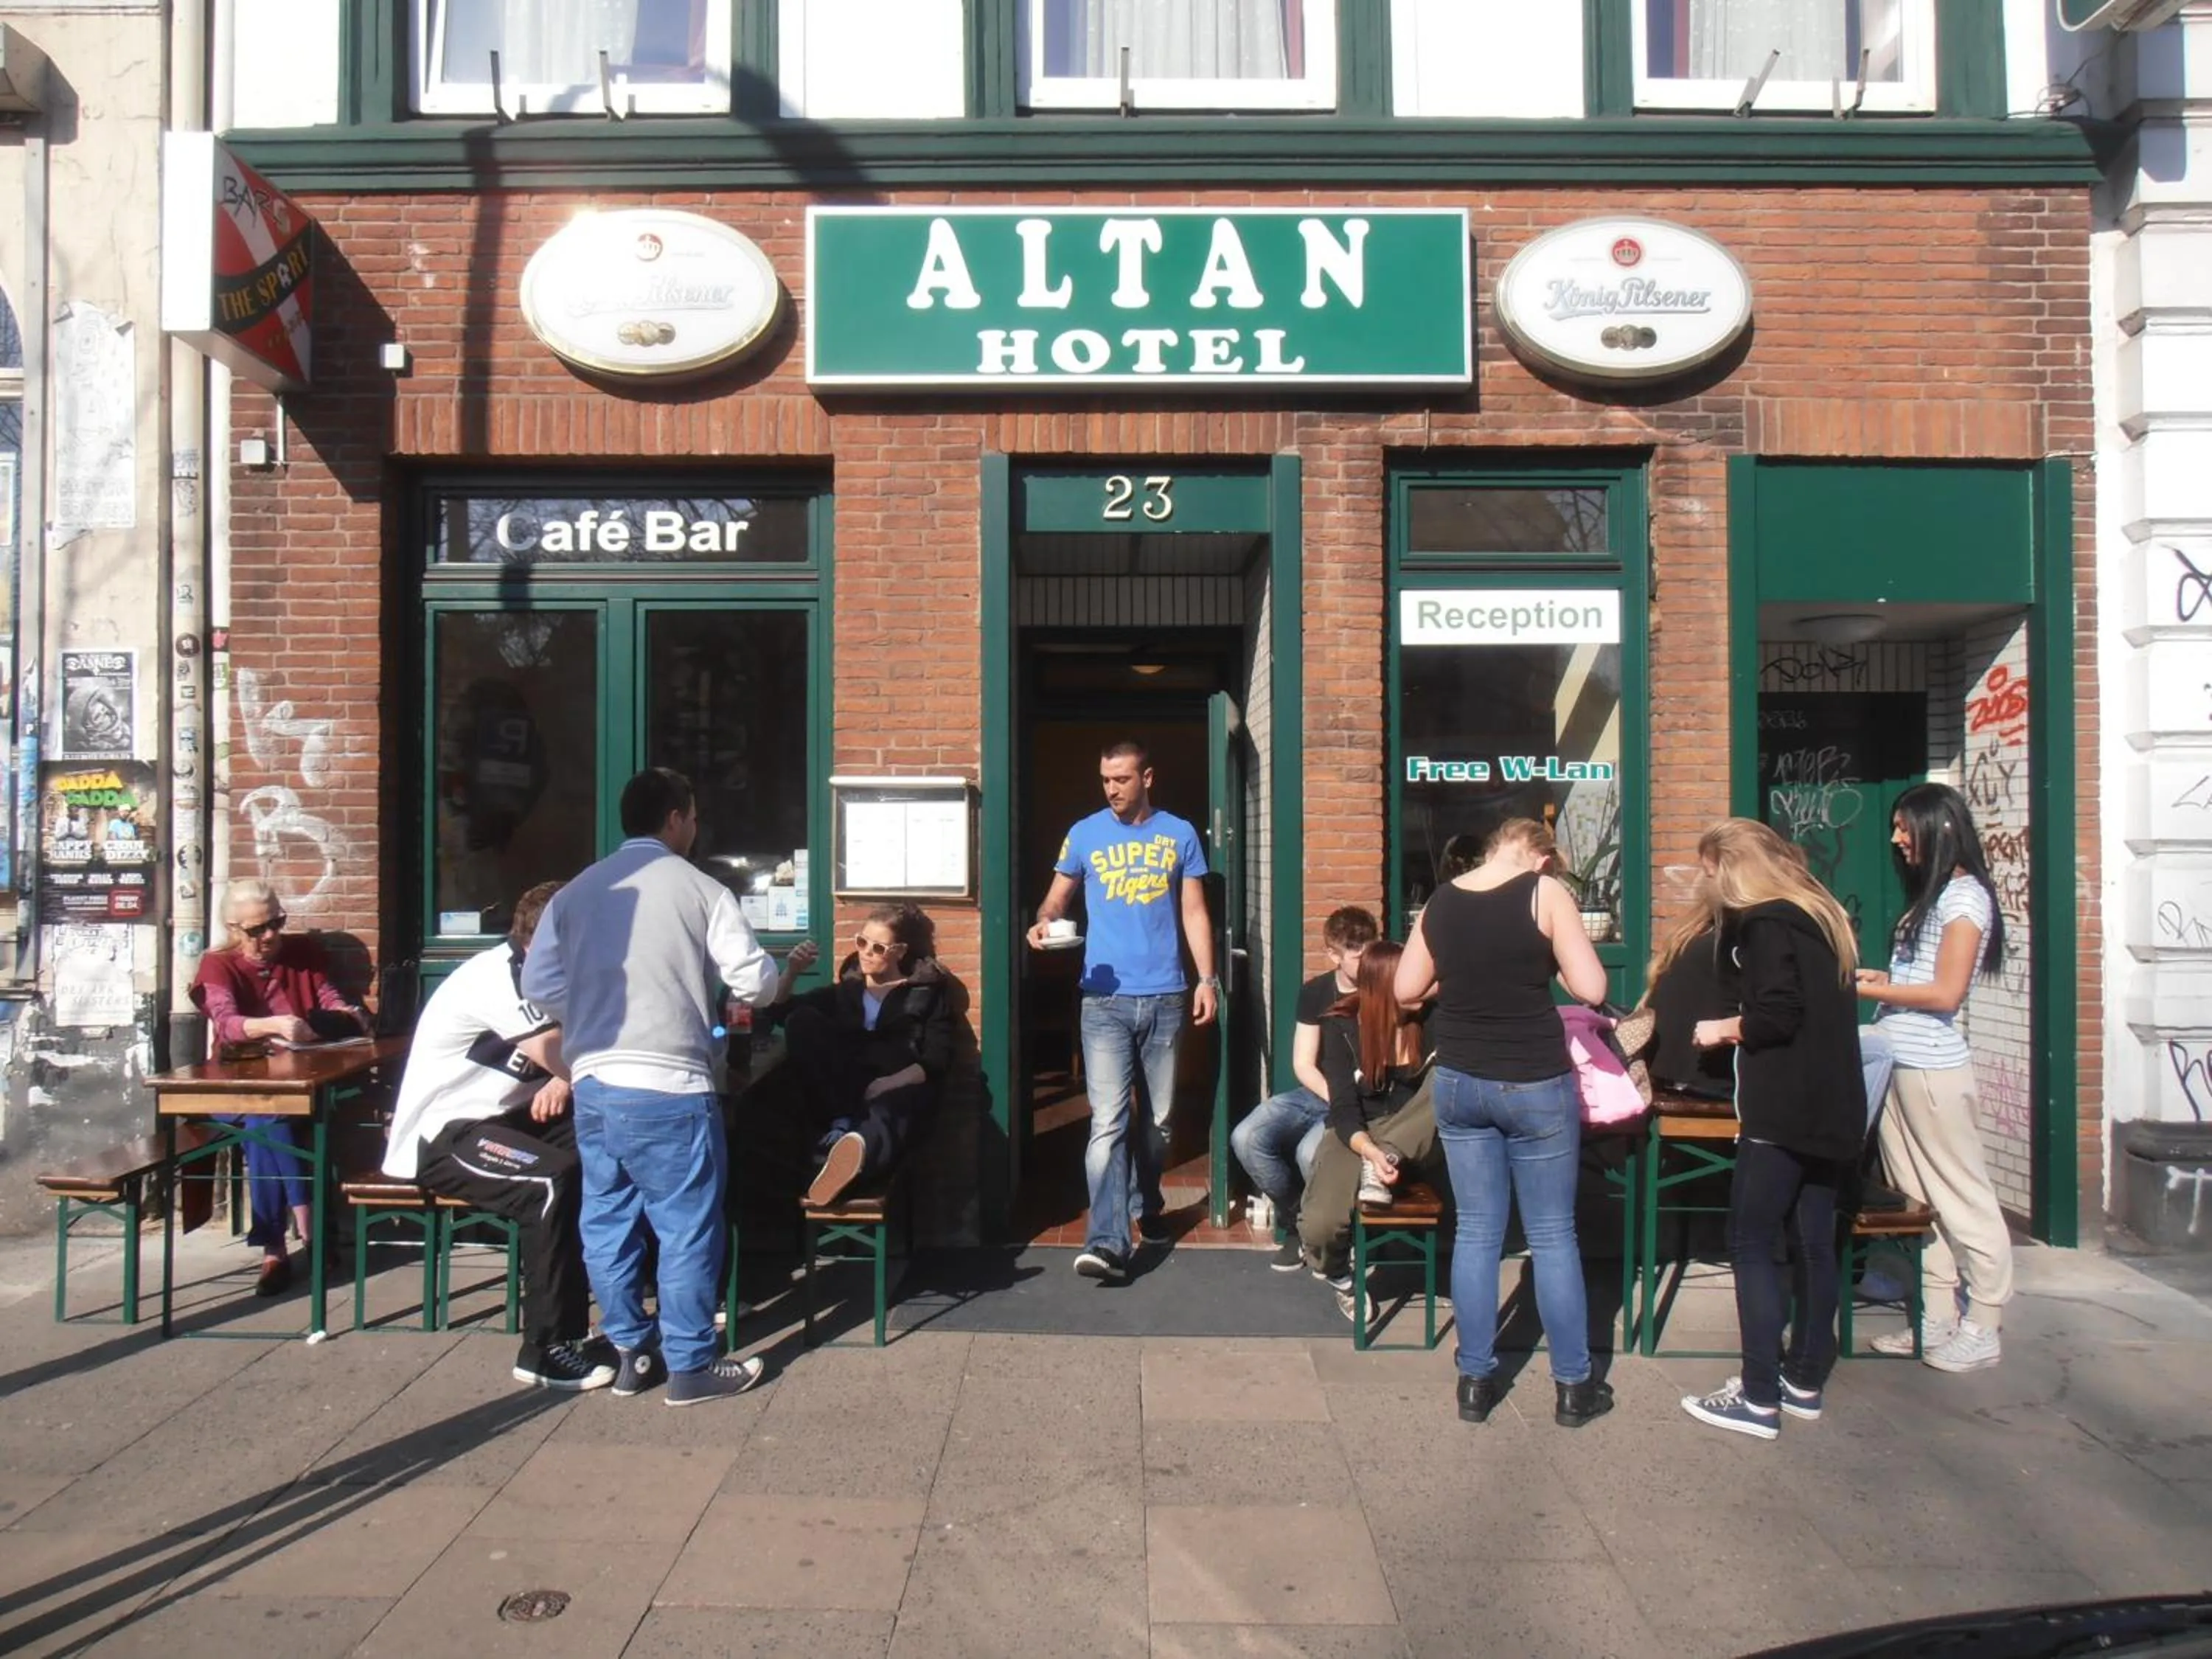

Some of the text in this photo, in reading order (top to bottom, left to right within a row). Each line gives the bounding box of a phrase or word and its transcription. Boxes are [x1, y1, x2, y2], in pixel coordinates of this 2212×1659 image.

[906, 216, 1370, 309] ALTAN
[217, 286, 257, 321] THE
[1618, 277, 1711, 313] Pilsener
[976, 328, 1305, 373] HOTEL
[1103, 475, 1172, 520] 23
[496, 509, 748, 552] Café Bar
[1417, 600, 1603, 636] Reception
[1407, 756, 1613, 782] Free W-Lan
[1091, 842, 1177, 873] SUPER
[1154, 835, 1175, 847] DRY
[1100, 867, 1169, 905] Tigers
